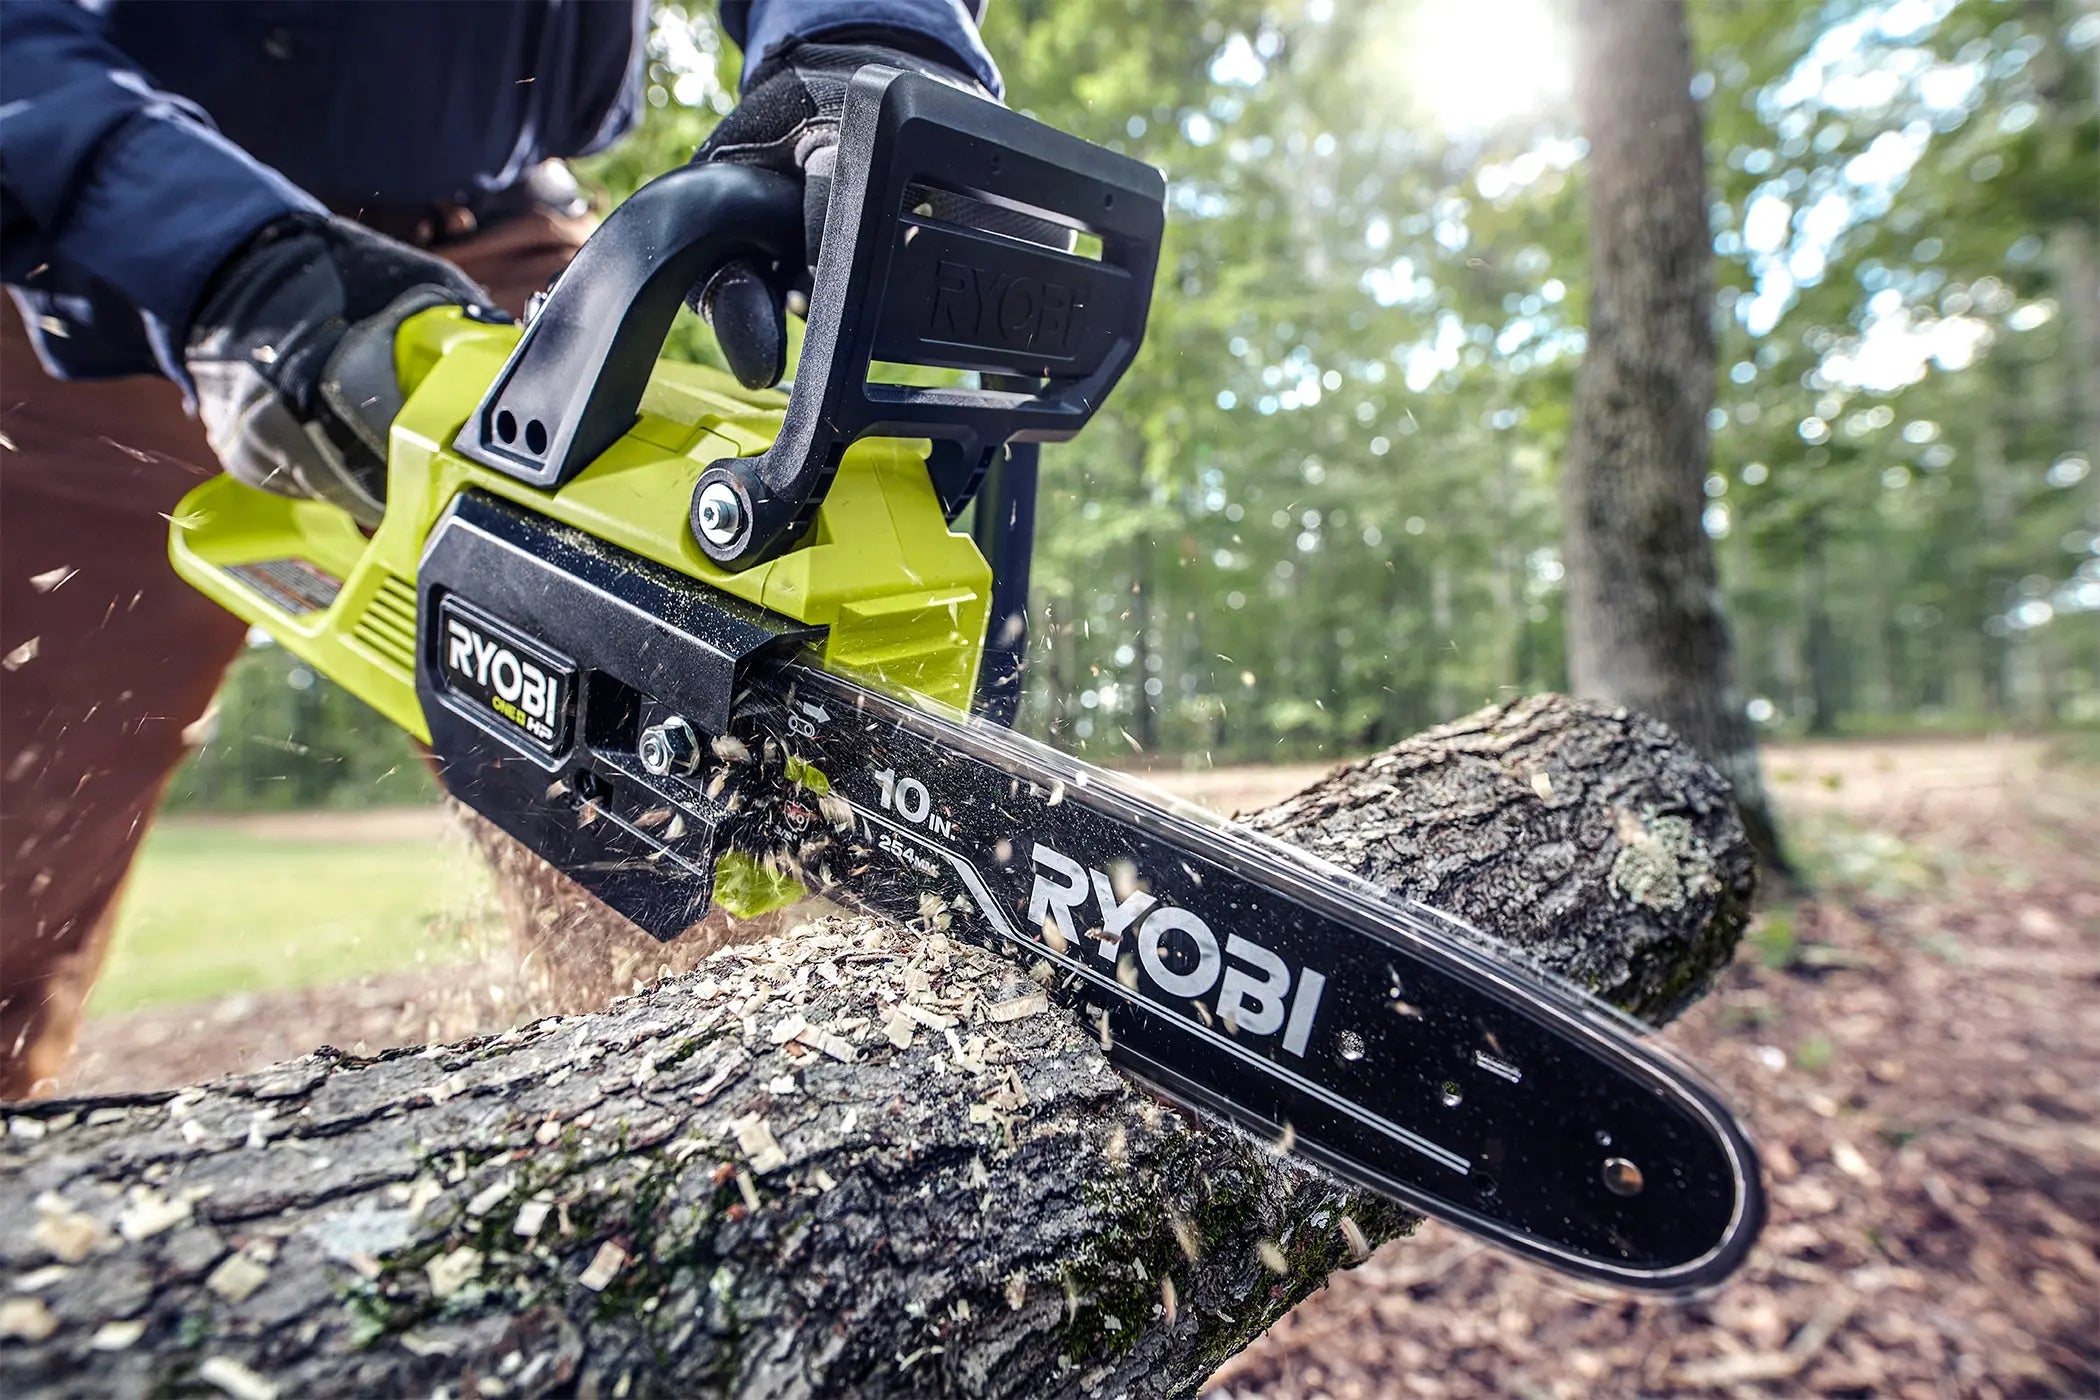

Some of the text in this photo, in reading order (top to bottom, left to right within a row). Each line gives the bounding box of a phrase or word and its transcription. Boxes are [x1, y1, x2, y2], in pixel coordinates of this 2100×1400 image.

[931, 258, 1090, 348] RYOBI
[448, 619, 558, 727] RYOBI
[526, 716, 553, 740] HP
[874, 767, 930, 823] 10
[1028, 842, 1327, 1058] RYOBI
